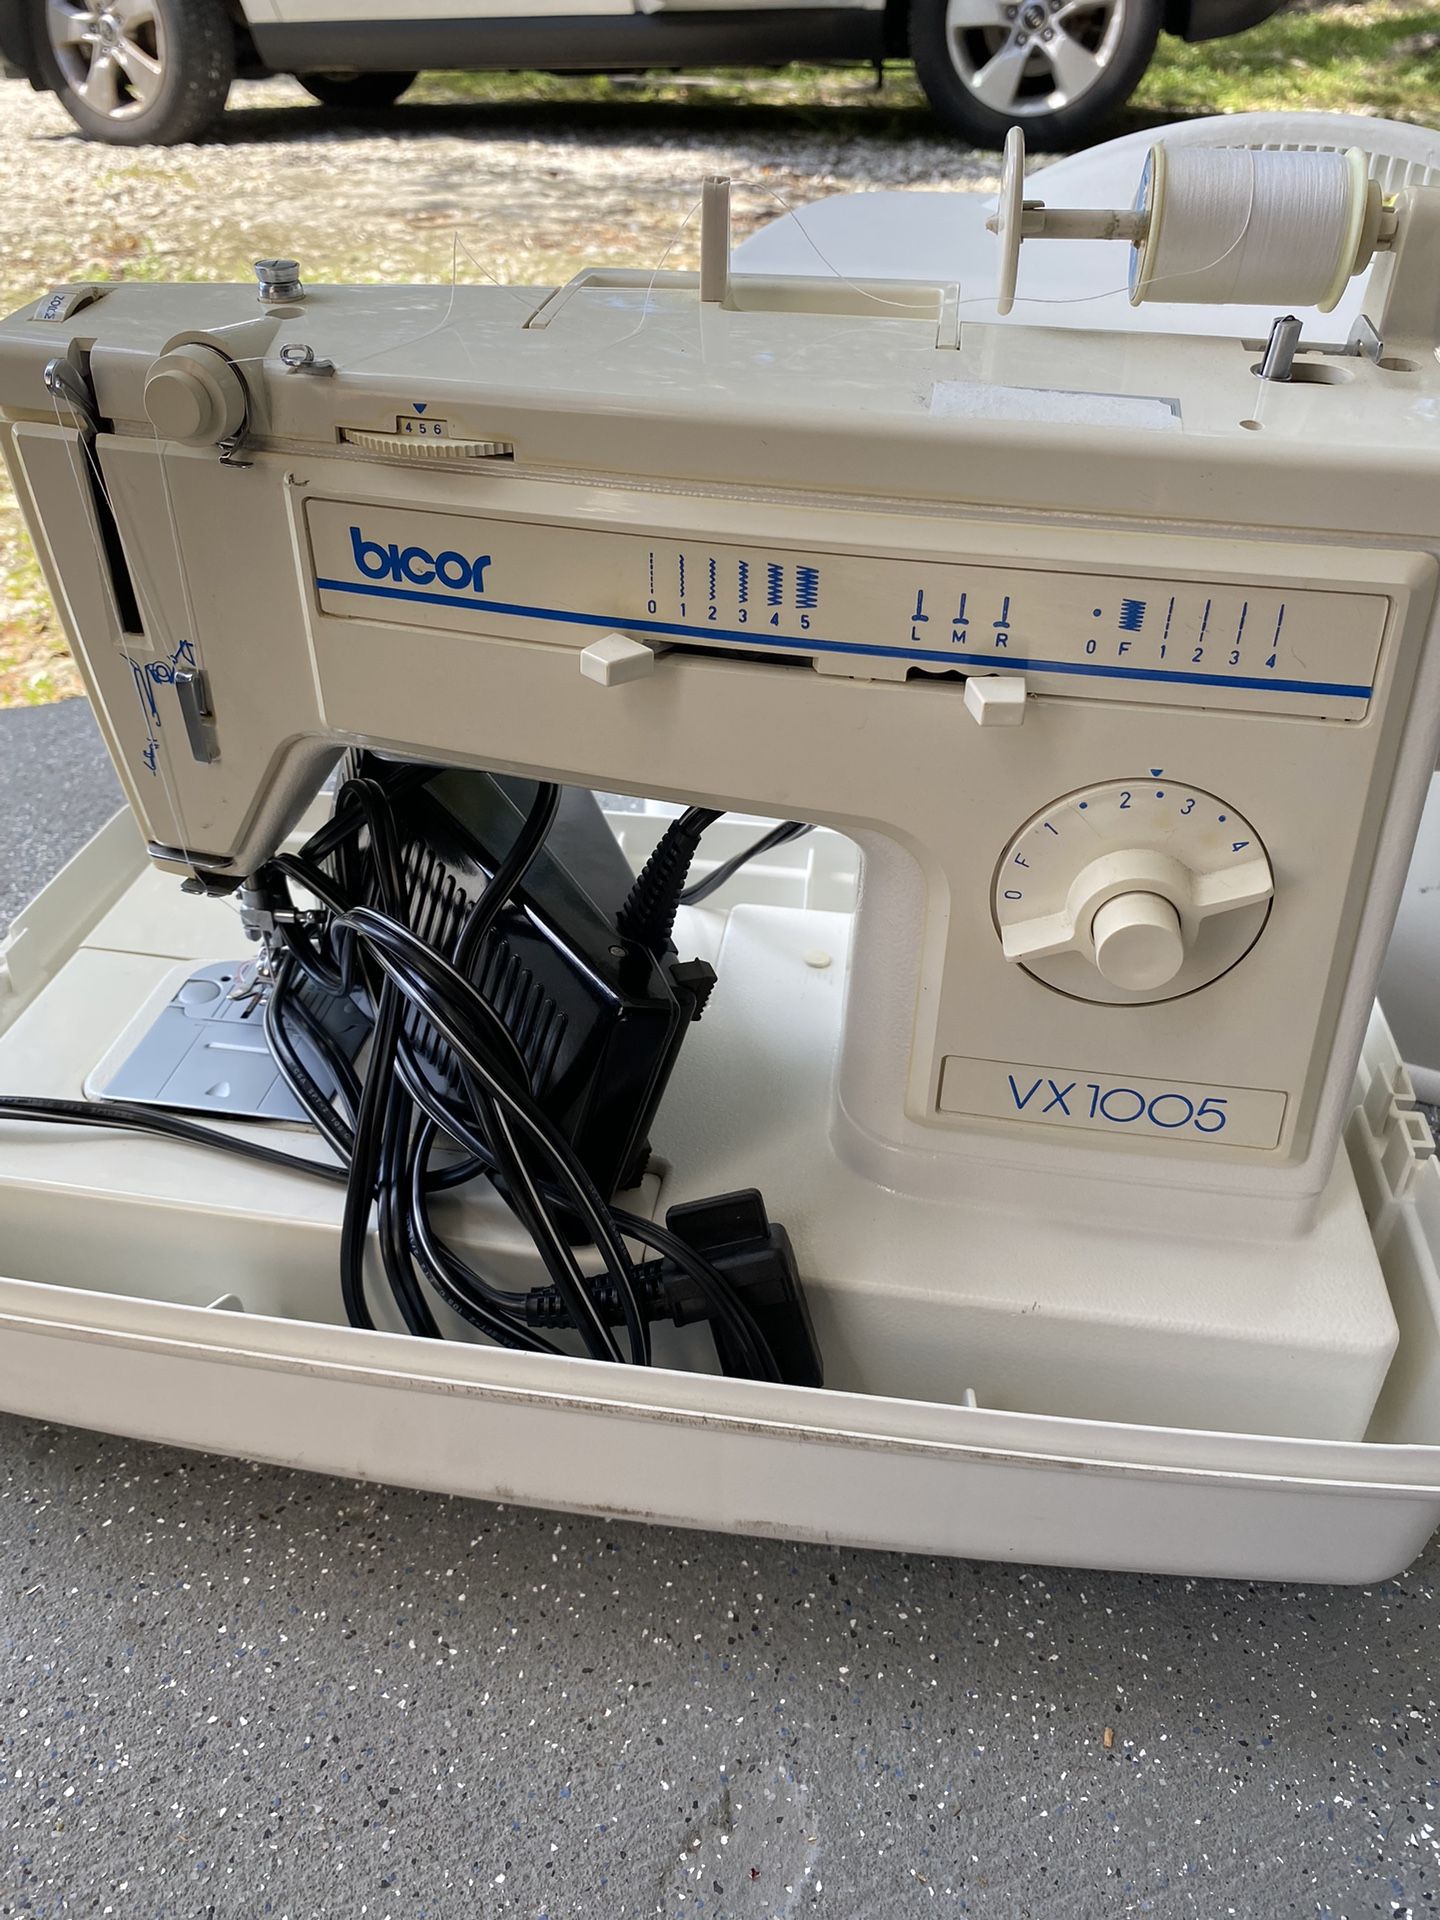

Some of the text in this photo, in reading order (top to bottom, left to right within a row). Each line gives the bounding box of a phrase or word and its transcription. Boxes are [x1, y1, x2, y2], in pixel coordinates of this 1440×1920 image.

[404, 421, 442, 435] 4 5 6
[349, 526, 492, 594] bicor
[647, 599, 811, 630] 0 1 2 3 4 5
[911, 625, 1009, 648] L M R
[1085, 639, 1277, 669] 0 F 1 2 3 4
[1004, 791, 1250, 900] 0 F 1 2 3 4
